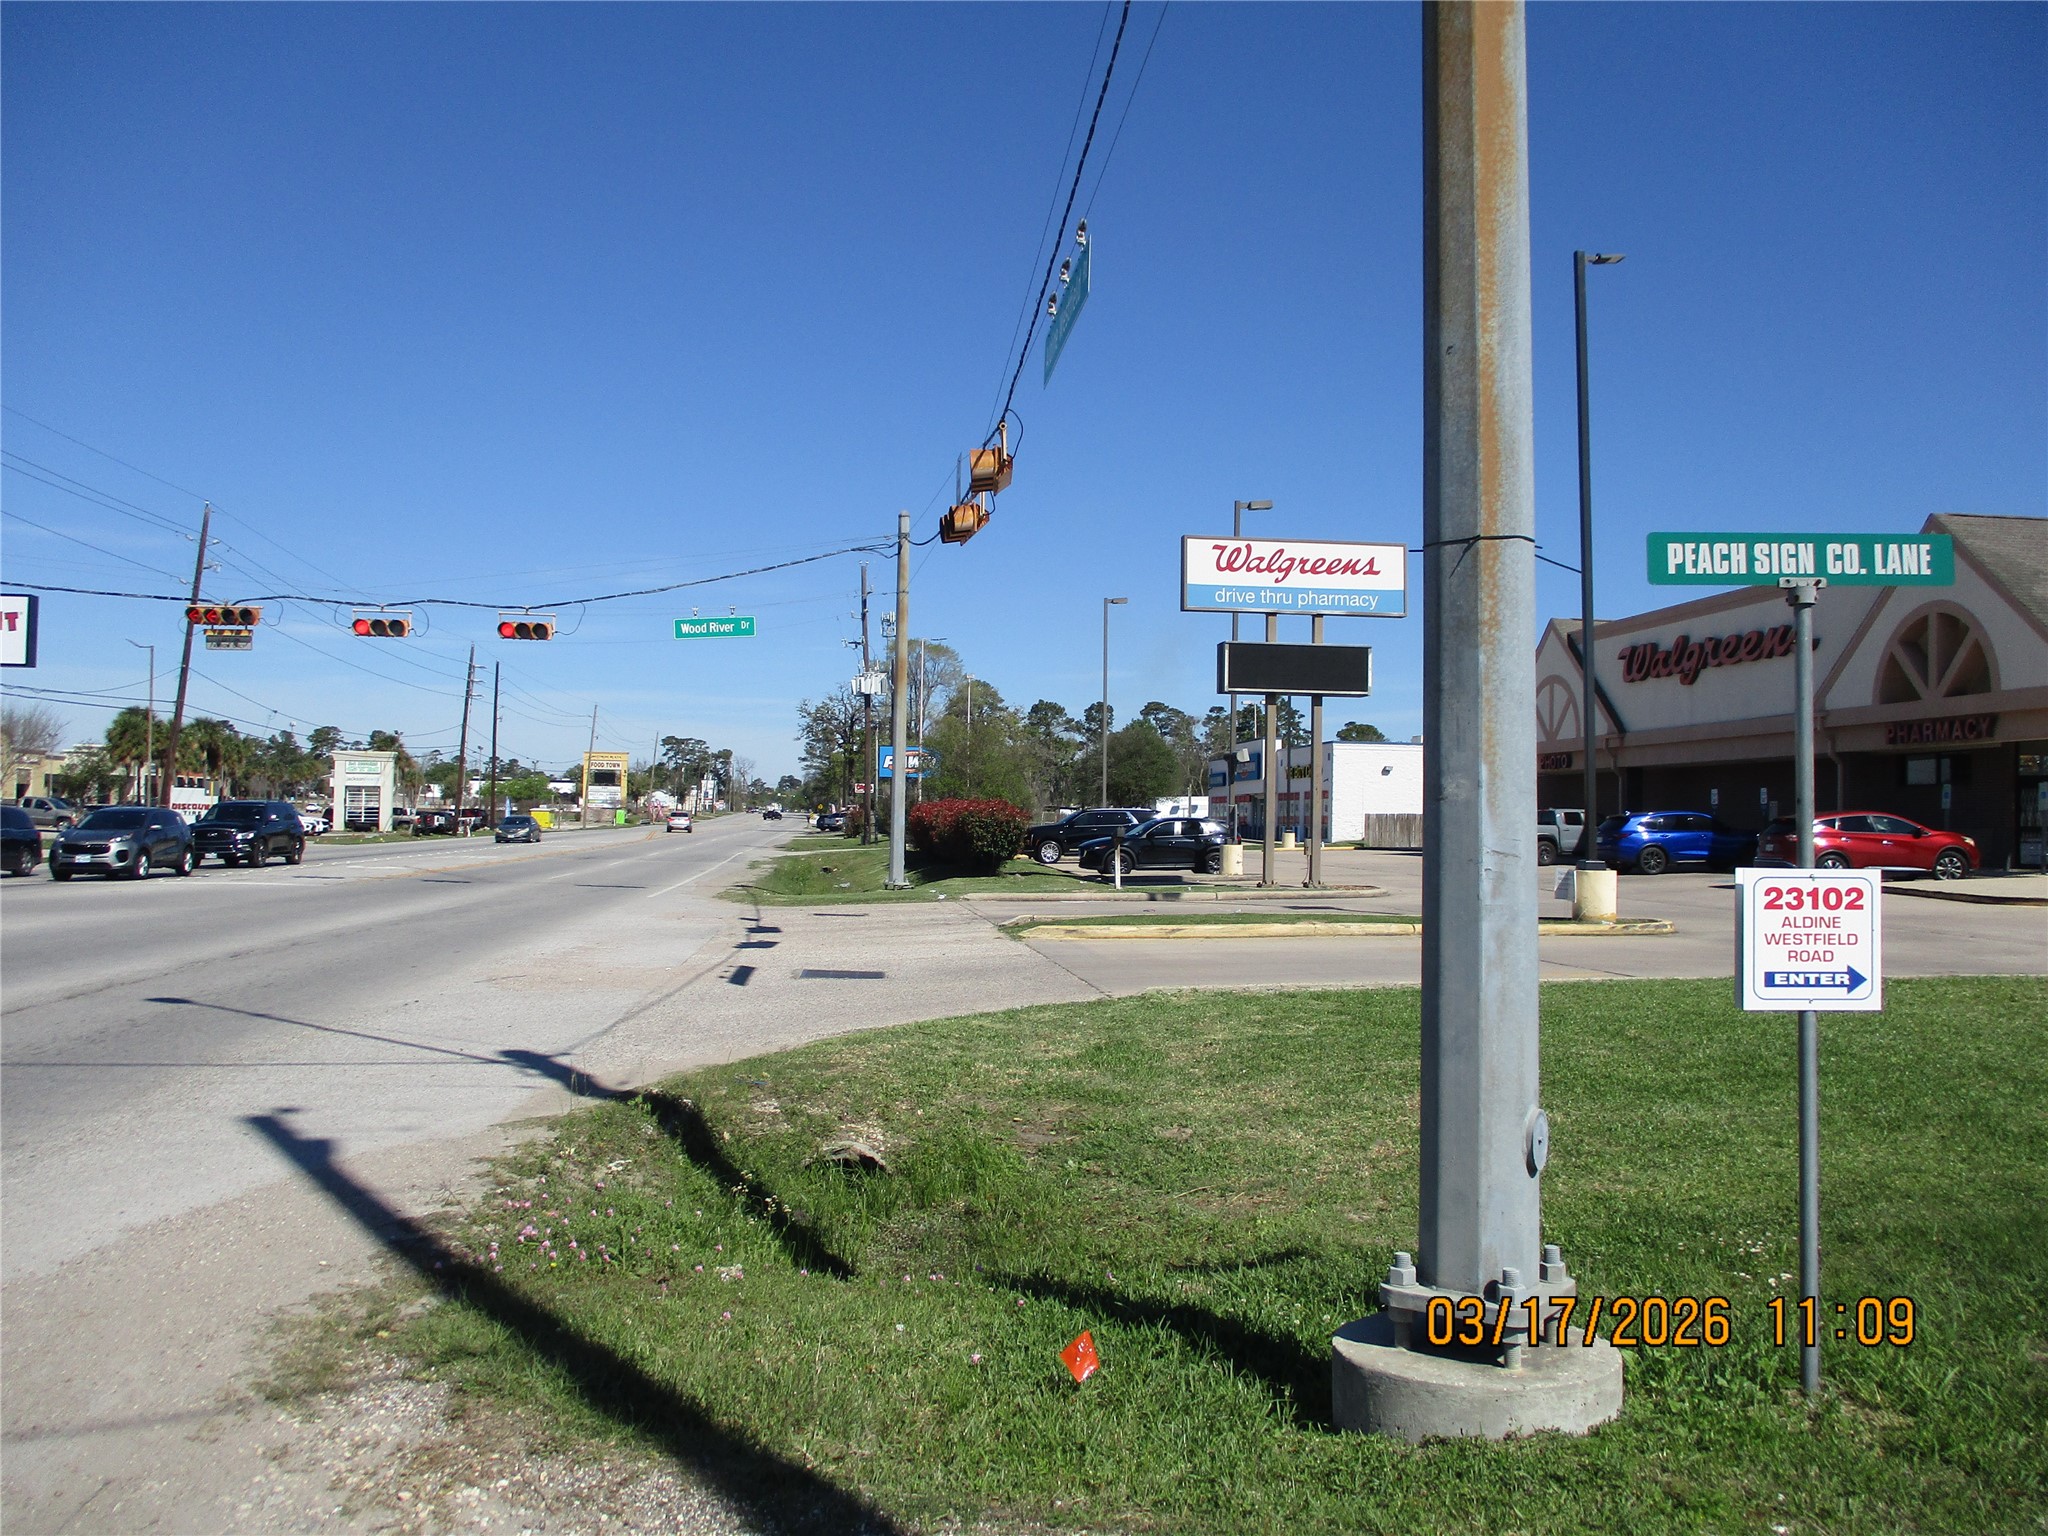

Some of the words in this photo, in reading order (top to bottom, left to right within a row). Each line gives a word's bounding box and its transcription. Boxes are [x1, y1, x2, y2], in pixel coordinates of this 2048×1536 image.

[1212, 543, 1381, 584] Walgreens
[1667, 542, 1747, 575] PEACH
[1754, 542, 1815, 575] SIGN
[1826, 543, 1868, 575] CO.
[1874, 543, 1932, 576] LANE
[1215, 588, 1255, 604] drive
[1260, 590, 1292, 605] thru
[1298, 591, 1378, 610] pharmacy
[681, 623, 707, 634] Wood
[709, 621, 735, 633] River
[741, 620, 750, 629] Dr
[1617, 624, 1820, 685] Walgreen
[1886, 717, 1991, 744] PHARMACY
[1538, 754, 1567, 769] PHOTO
[1763, 887, 1864, 911] 23102
[1781, 916, 1841, 929] ALDINE
[1764, 933, 1858, 946] WESTFIELD
[1788, 950, 1834, 963] ROAD
[1774, 973, 1850, 985] ENTER
